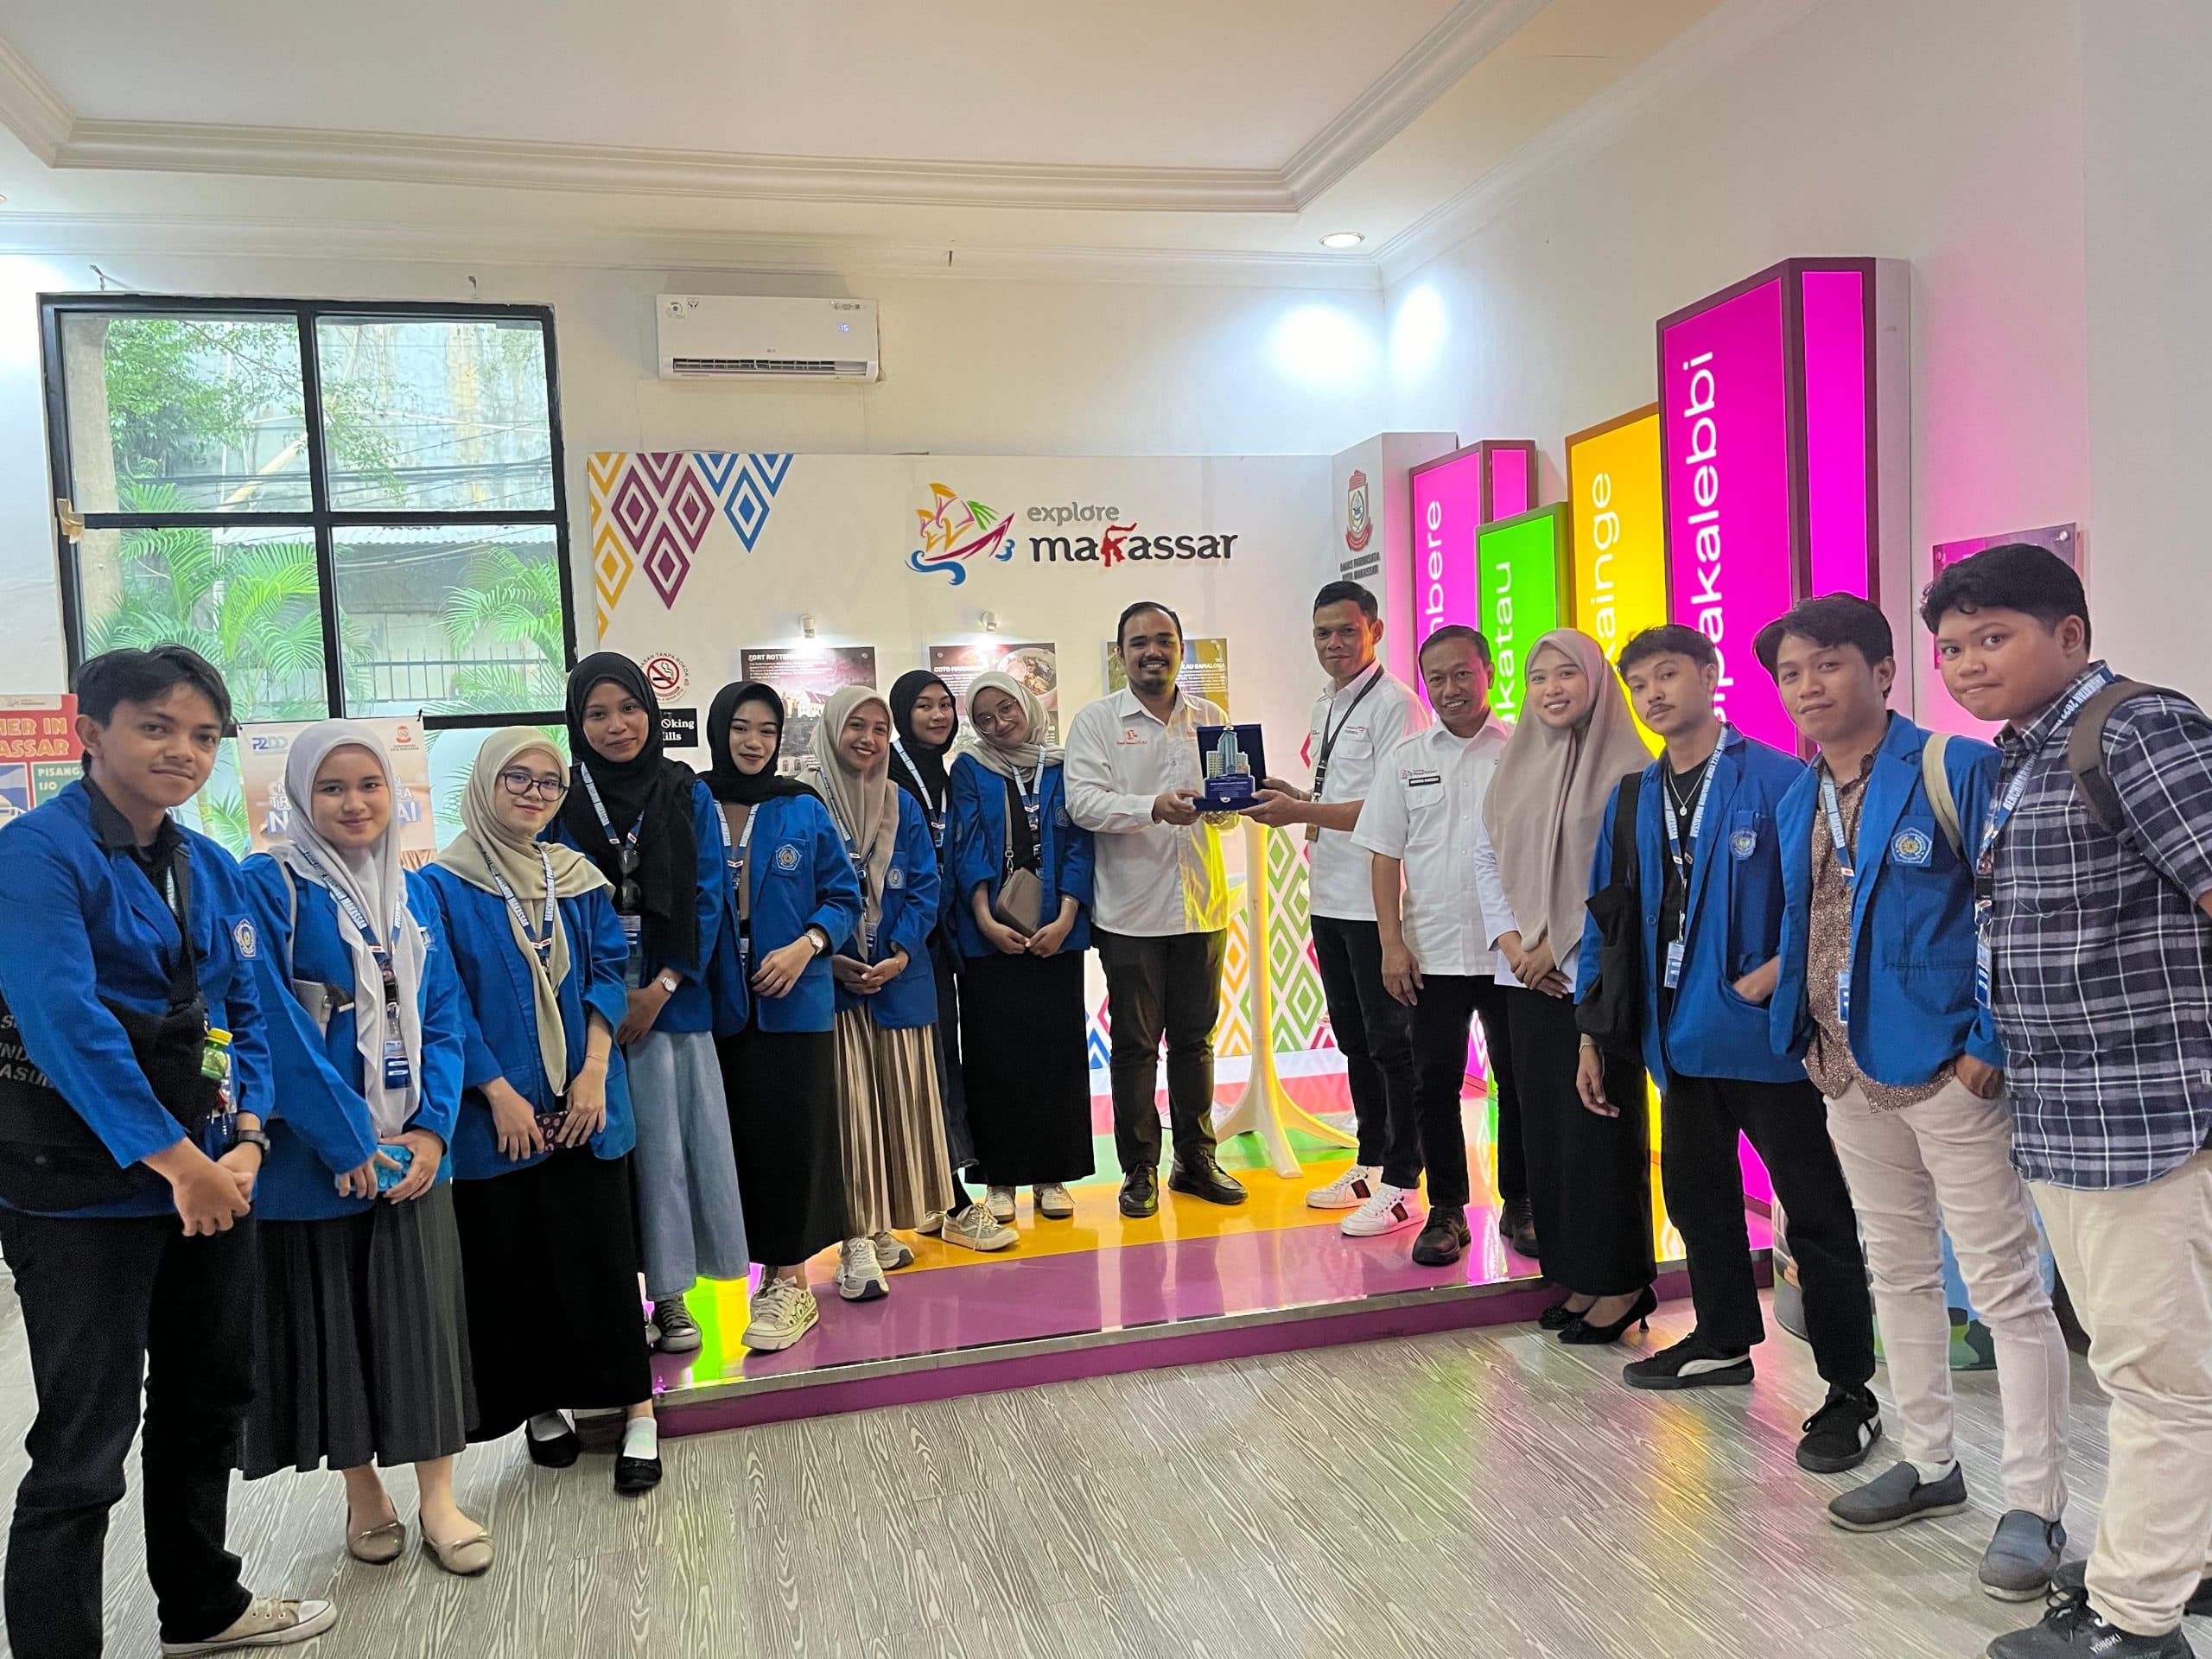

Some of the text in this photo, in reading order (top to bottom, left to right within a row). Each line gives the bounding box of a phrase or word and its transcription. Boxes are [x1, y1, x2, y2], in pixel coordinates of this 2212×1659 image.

[1027, 501, 1120, 526] explore
[1028, 522, 1239, 568] makassar
[43, 717, 67, 734] IN
[37, 766, 80, 777] PISANG
